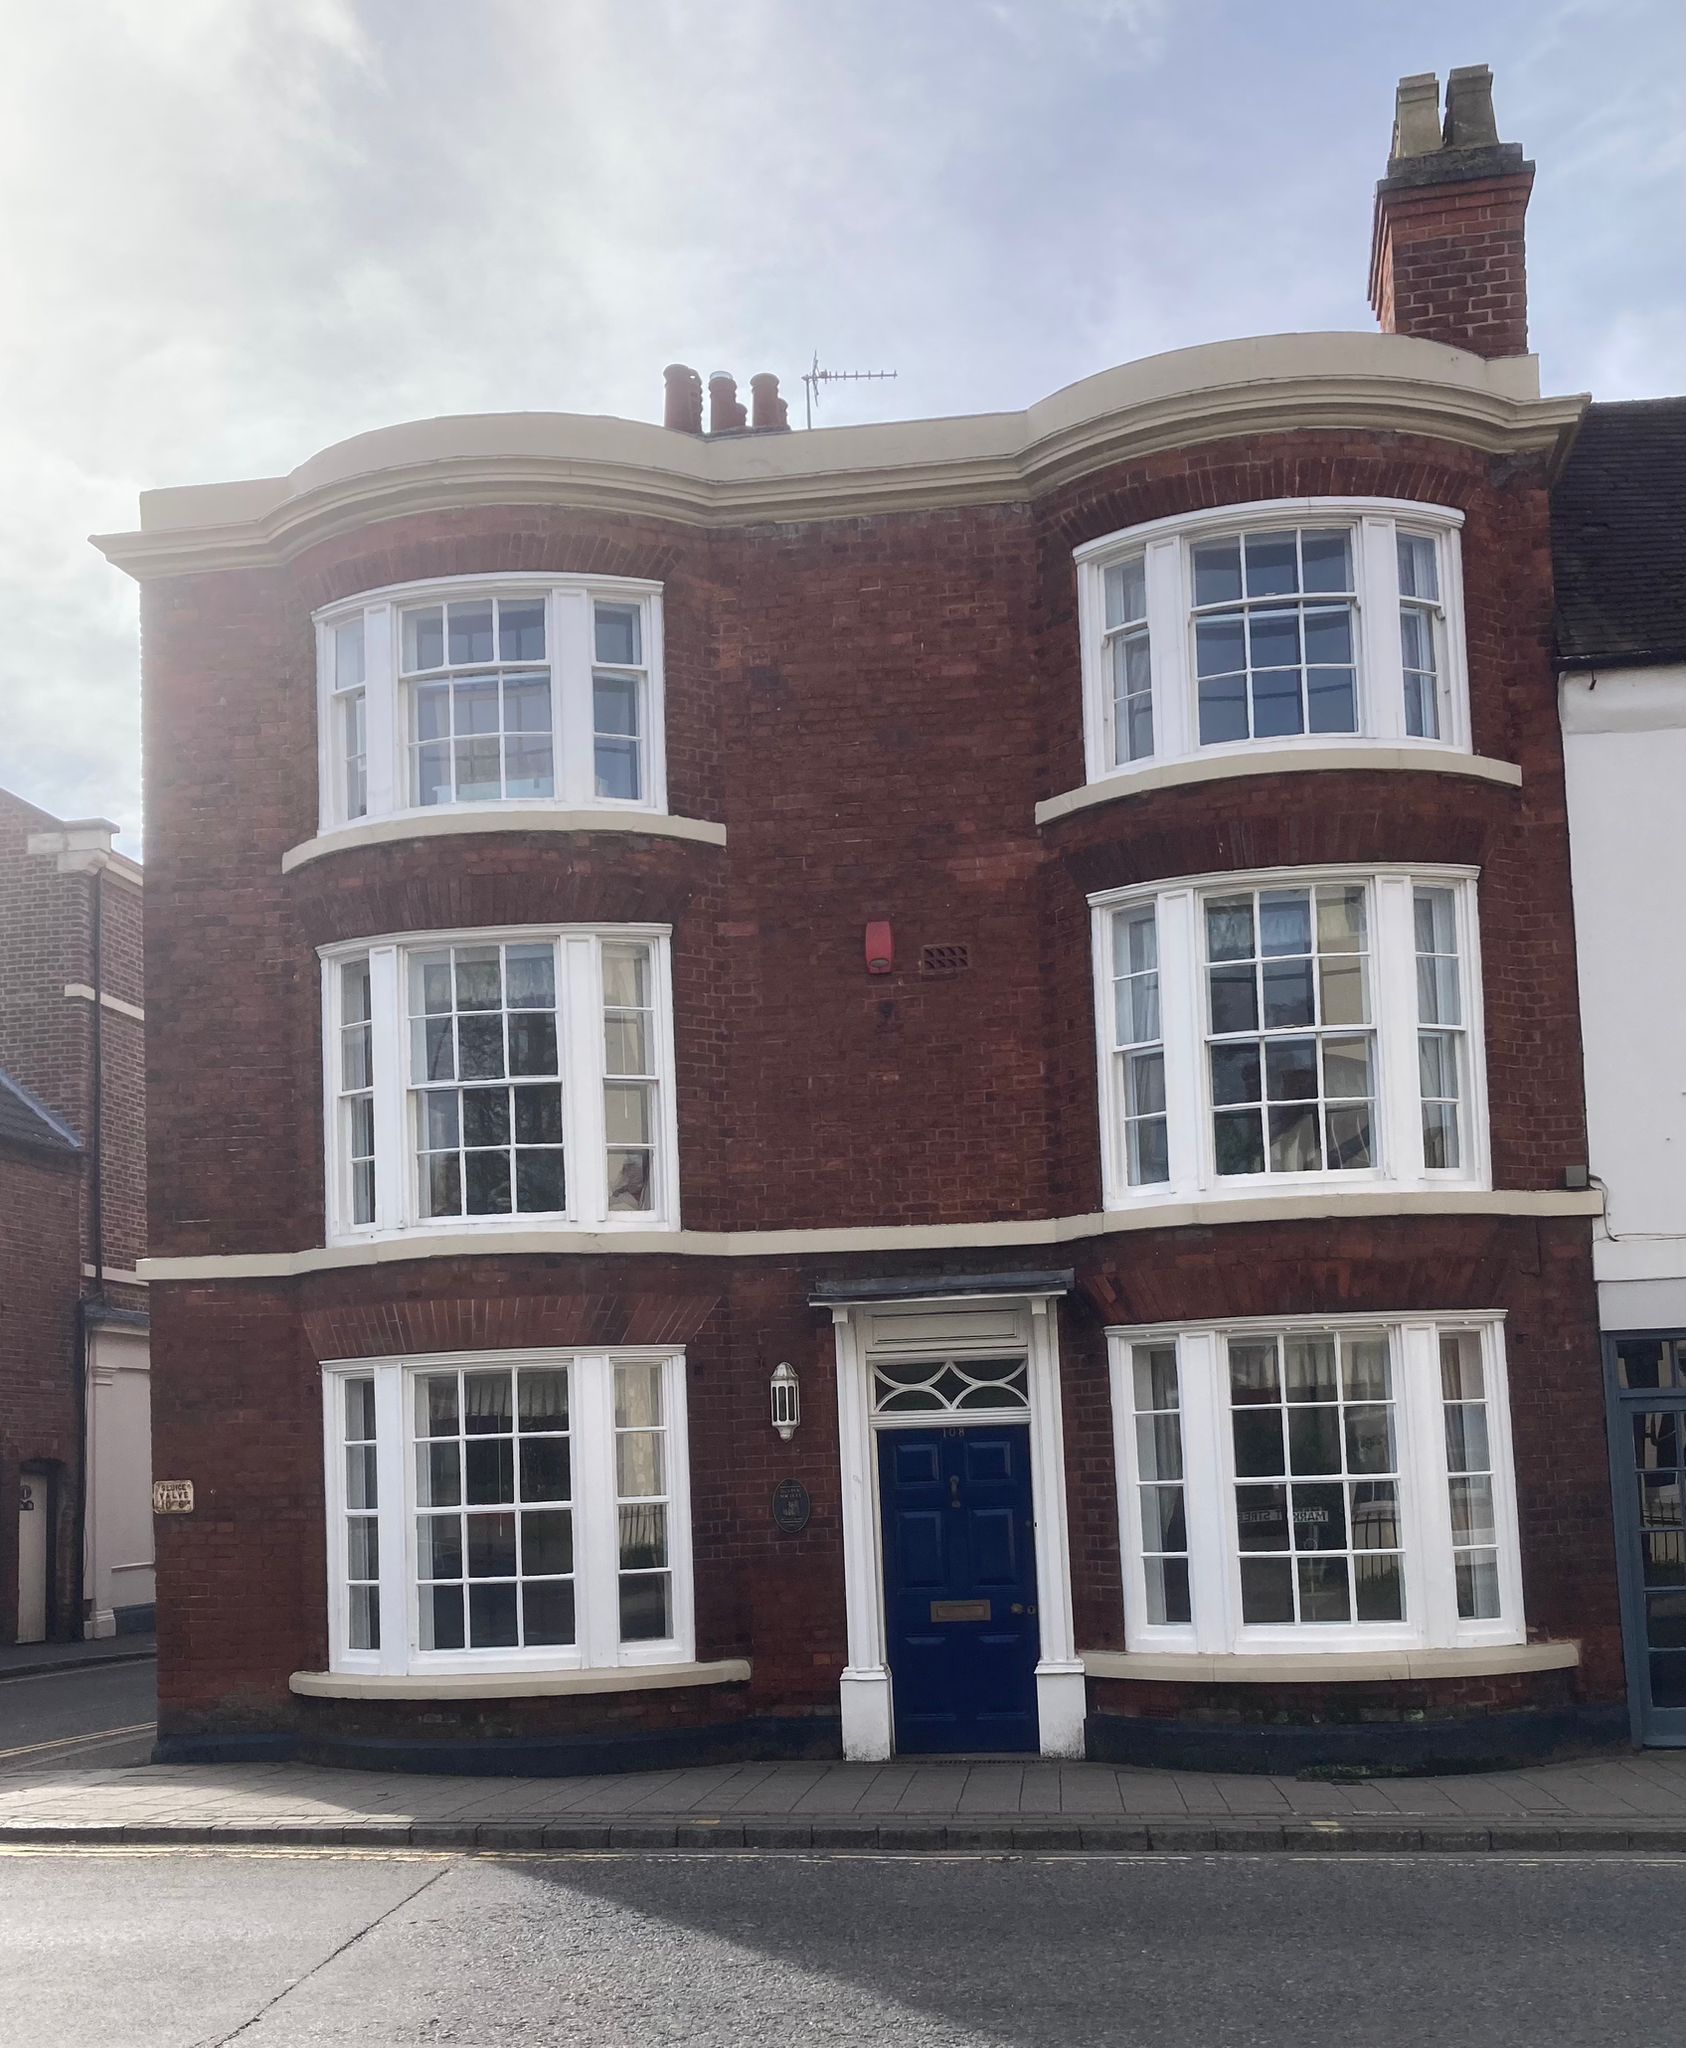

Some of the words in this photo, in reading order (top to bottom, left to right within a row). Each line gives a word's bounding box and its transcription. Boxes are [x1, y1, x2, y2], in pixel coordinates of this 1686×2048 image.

[943, 1427, 965, 1438] 108
[161, 1483, 187, 1491] SLUICE
[159, 1491, 189, 1500] VALVE
